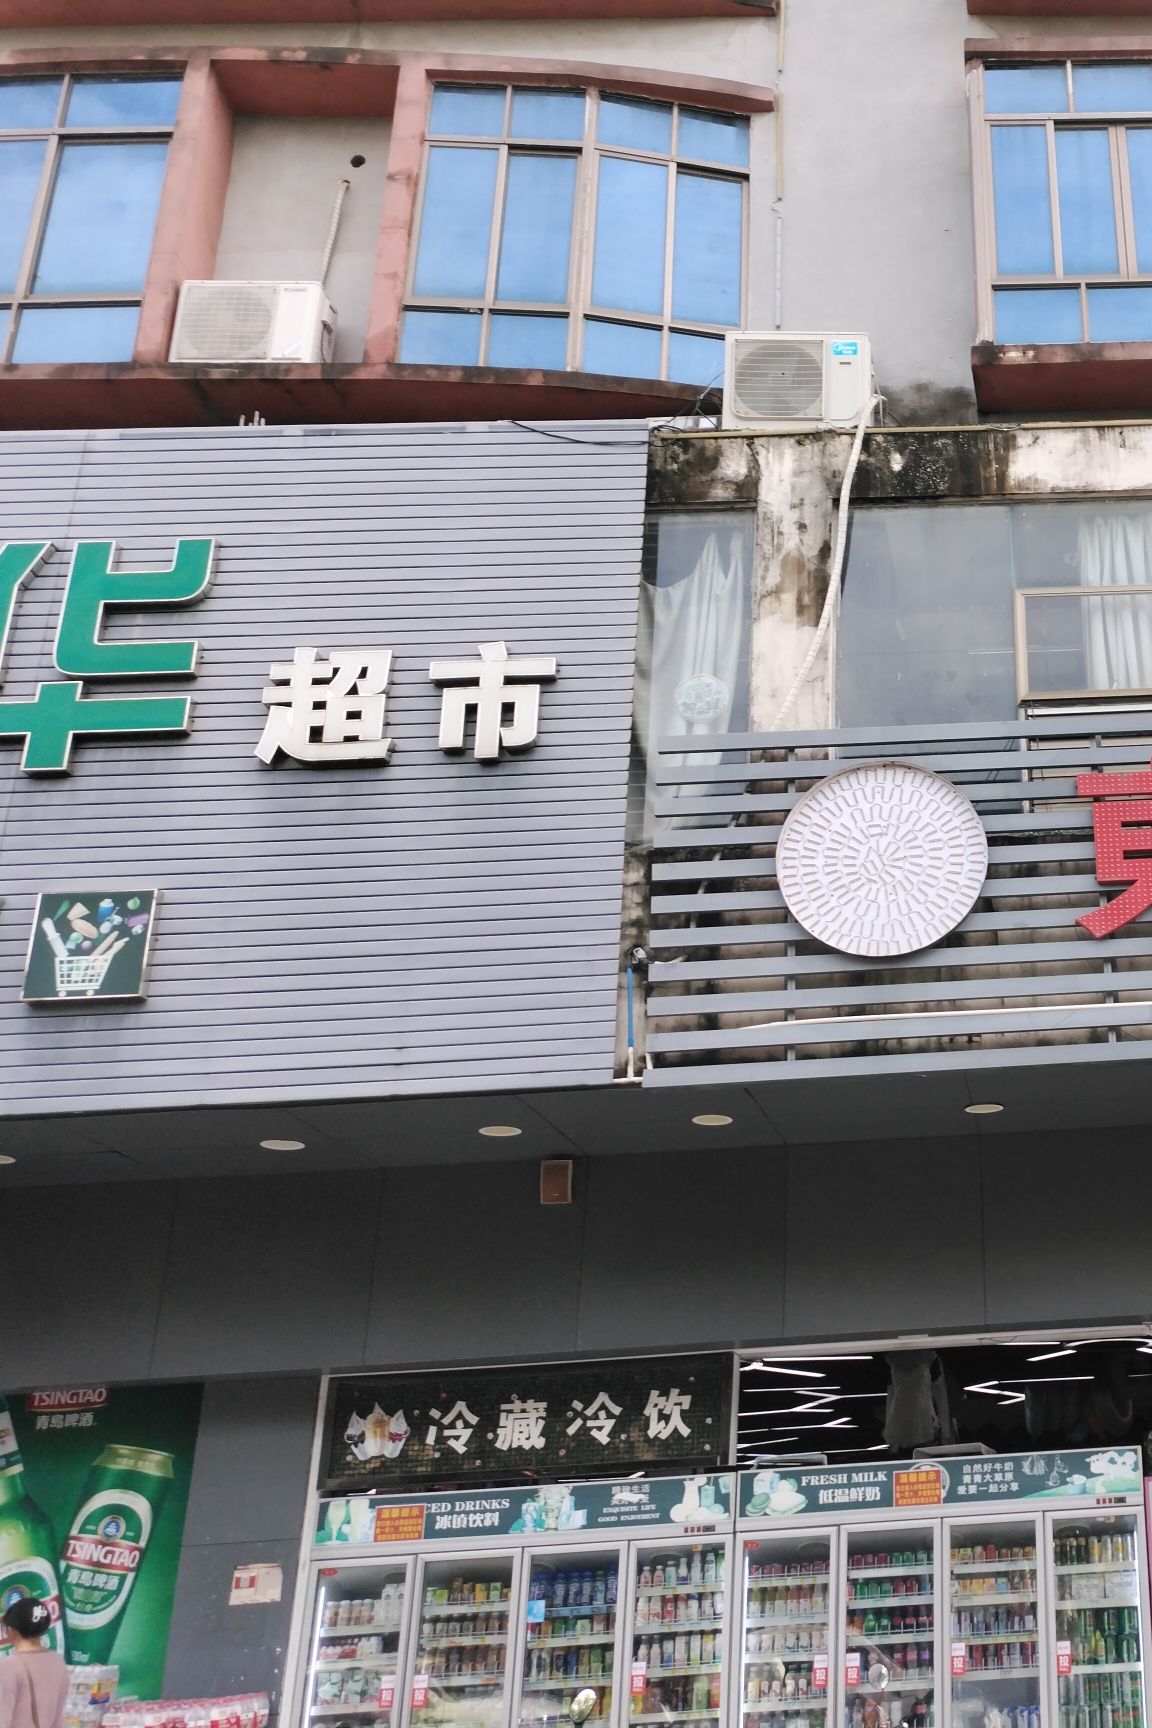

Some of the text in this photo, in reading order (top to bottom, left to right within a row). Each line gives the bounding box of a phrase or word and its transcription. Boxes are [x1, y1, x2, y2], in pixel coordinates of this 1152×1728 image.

[254, 641, 558, 765] 超市
[33, 1388, 107, 1406] TSINGTAO
[425, 1388, 692, 1455] 冷藏冷饮
[962, 1461, 1014, 1474] 自然好牛奶
[801, 1471, 888, 1487] FRESH MILK
[818, 1486, 881, 1505] 低温鲜奶
[425, 1498, 511, 1514] CED DRINKS
[66, 1540, 140, 1568] TSINGTAO
